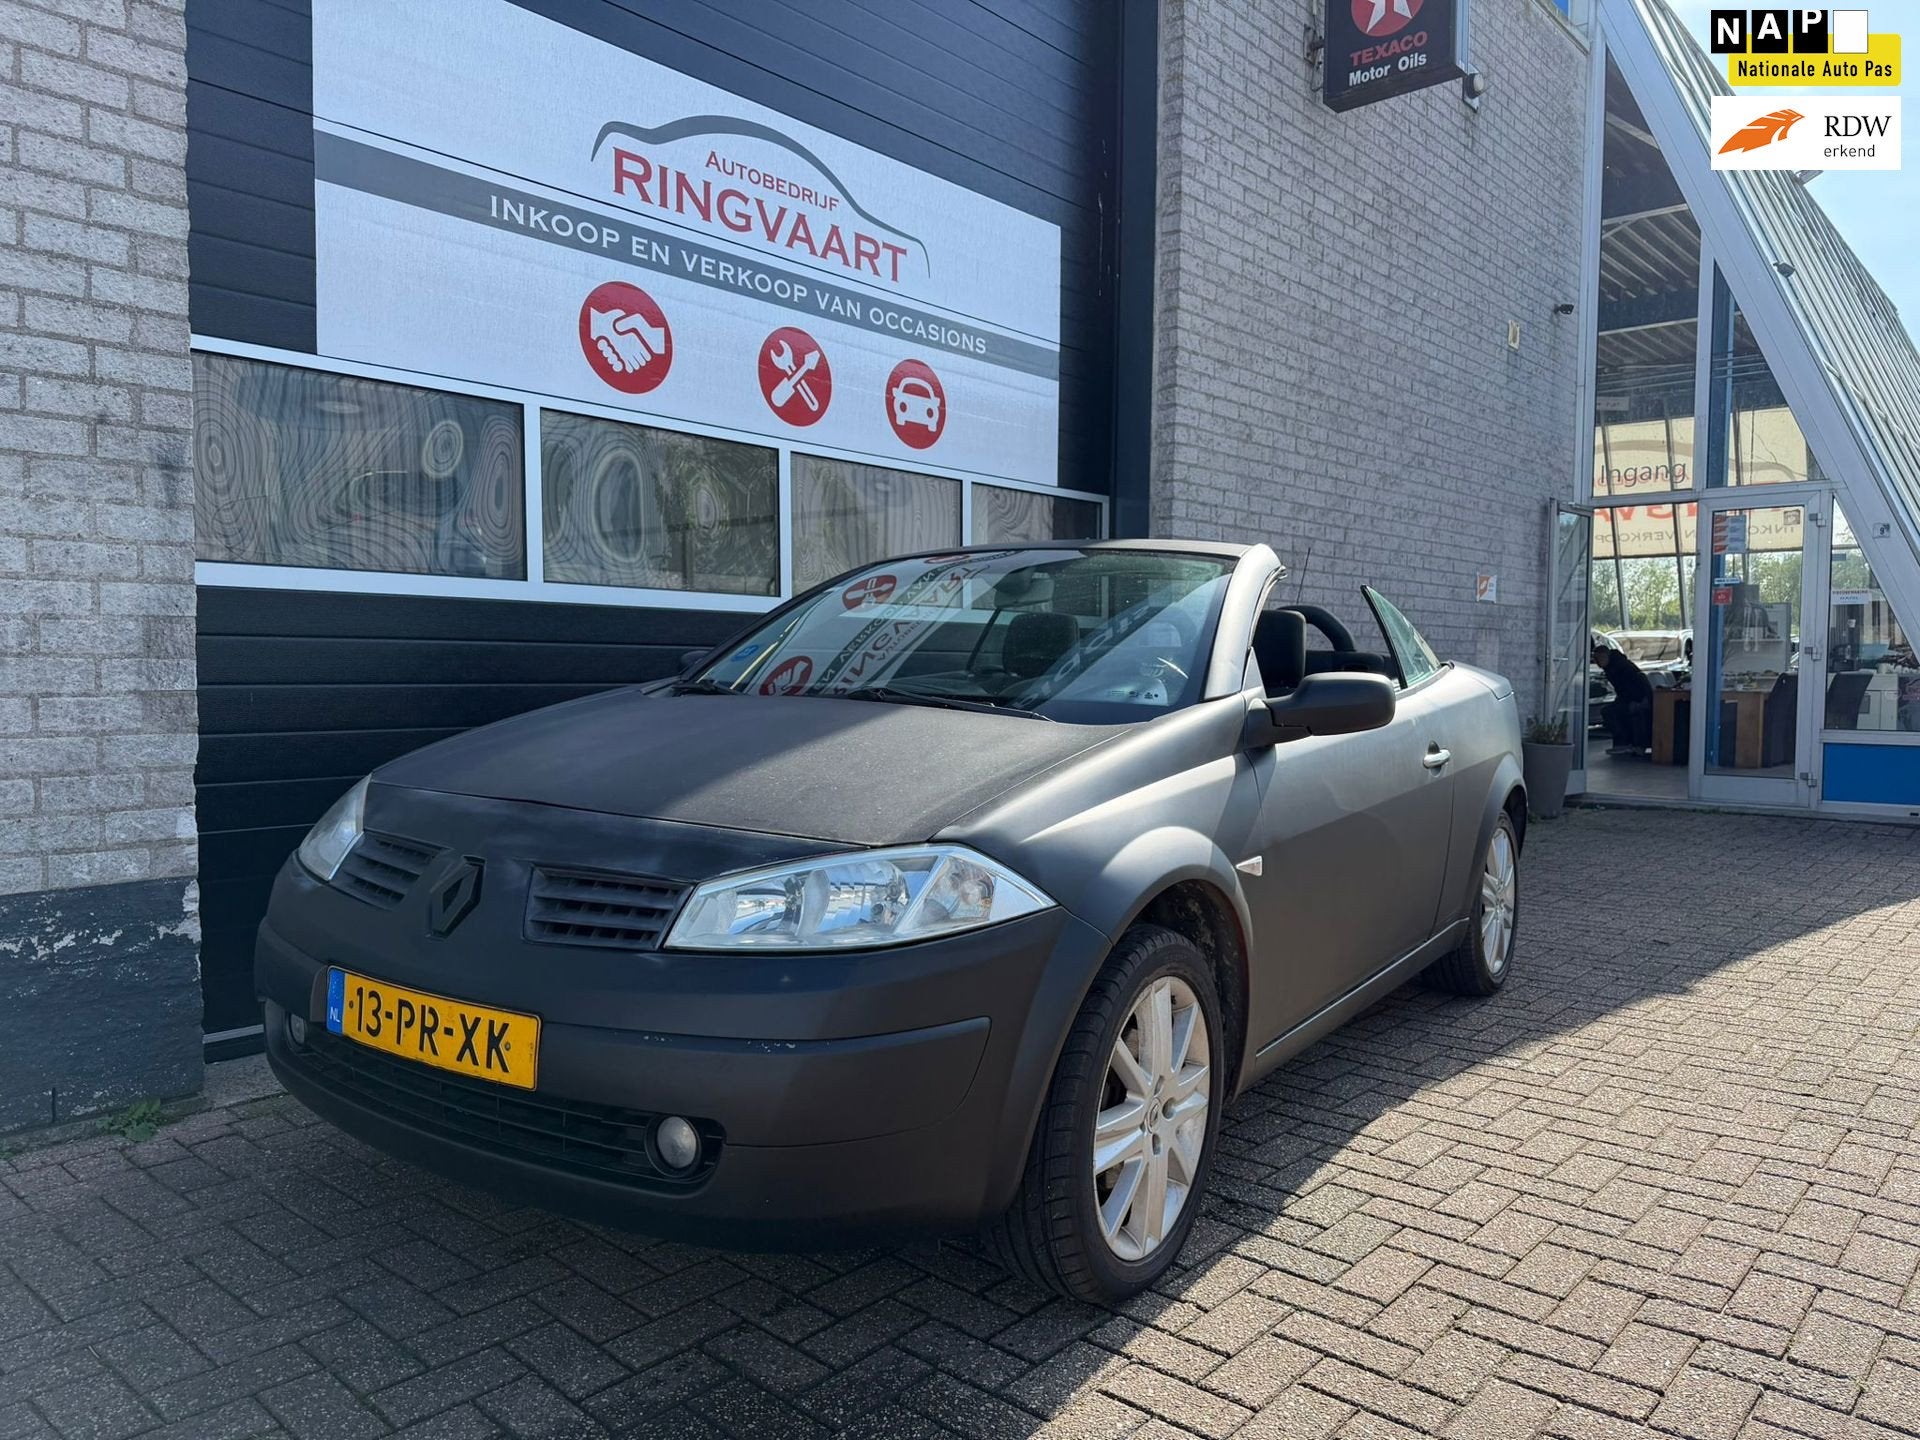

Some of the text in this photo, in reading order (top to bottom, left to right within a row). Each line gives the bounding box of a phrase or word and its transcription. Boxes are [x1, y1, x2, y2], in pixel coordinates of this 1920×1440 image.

[1350, 31, 1429, 66] TEXACO
[1349, 52, 1427, 87] Motor Oils
[612, 146, 907, 283] RINGVAART
[490, 195, 986, 354] INKOOP EN VERKOOP VAN OCCASIONS
[1601, 463, 1686, 487] Ingang
[329, 1006, 341, 1023] NL
[356, 986, 510, 1073] 13-PR-XK
